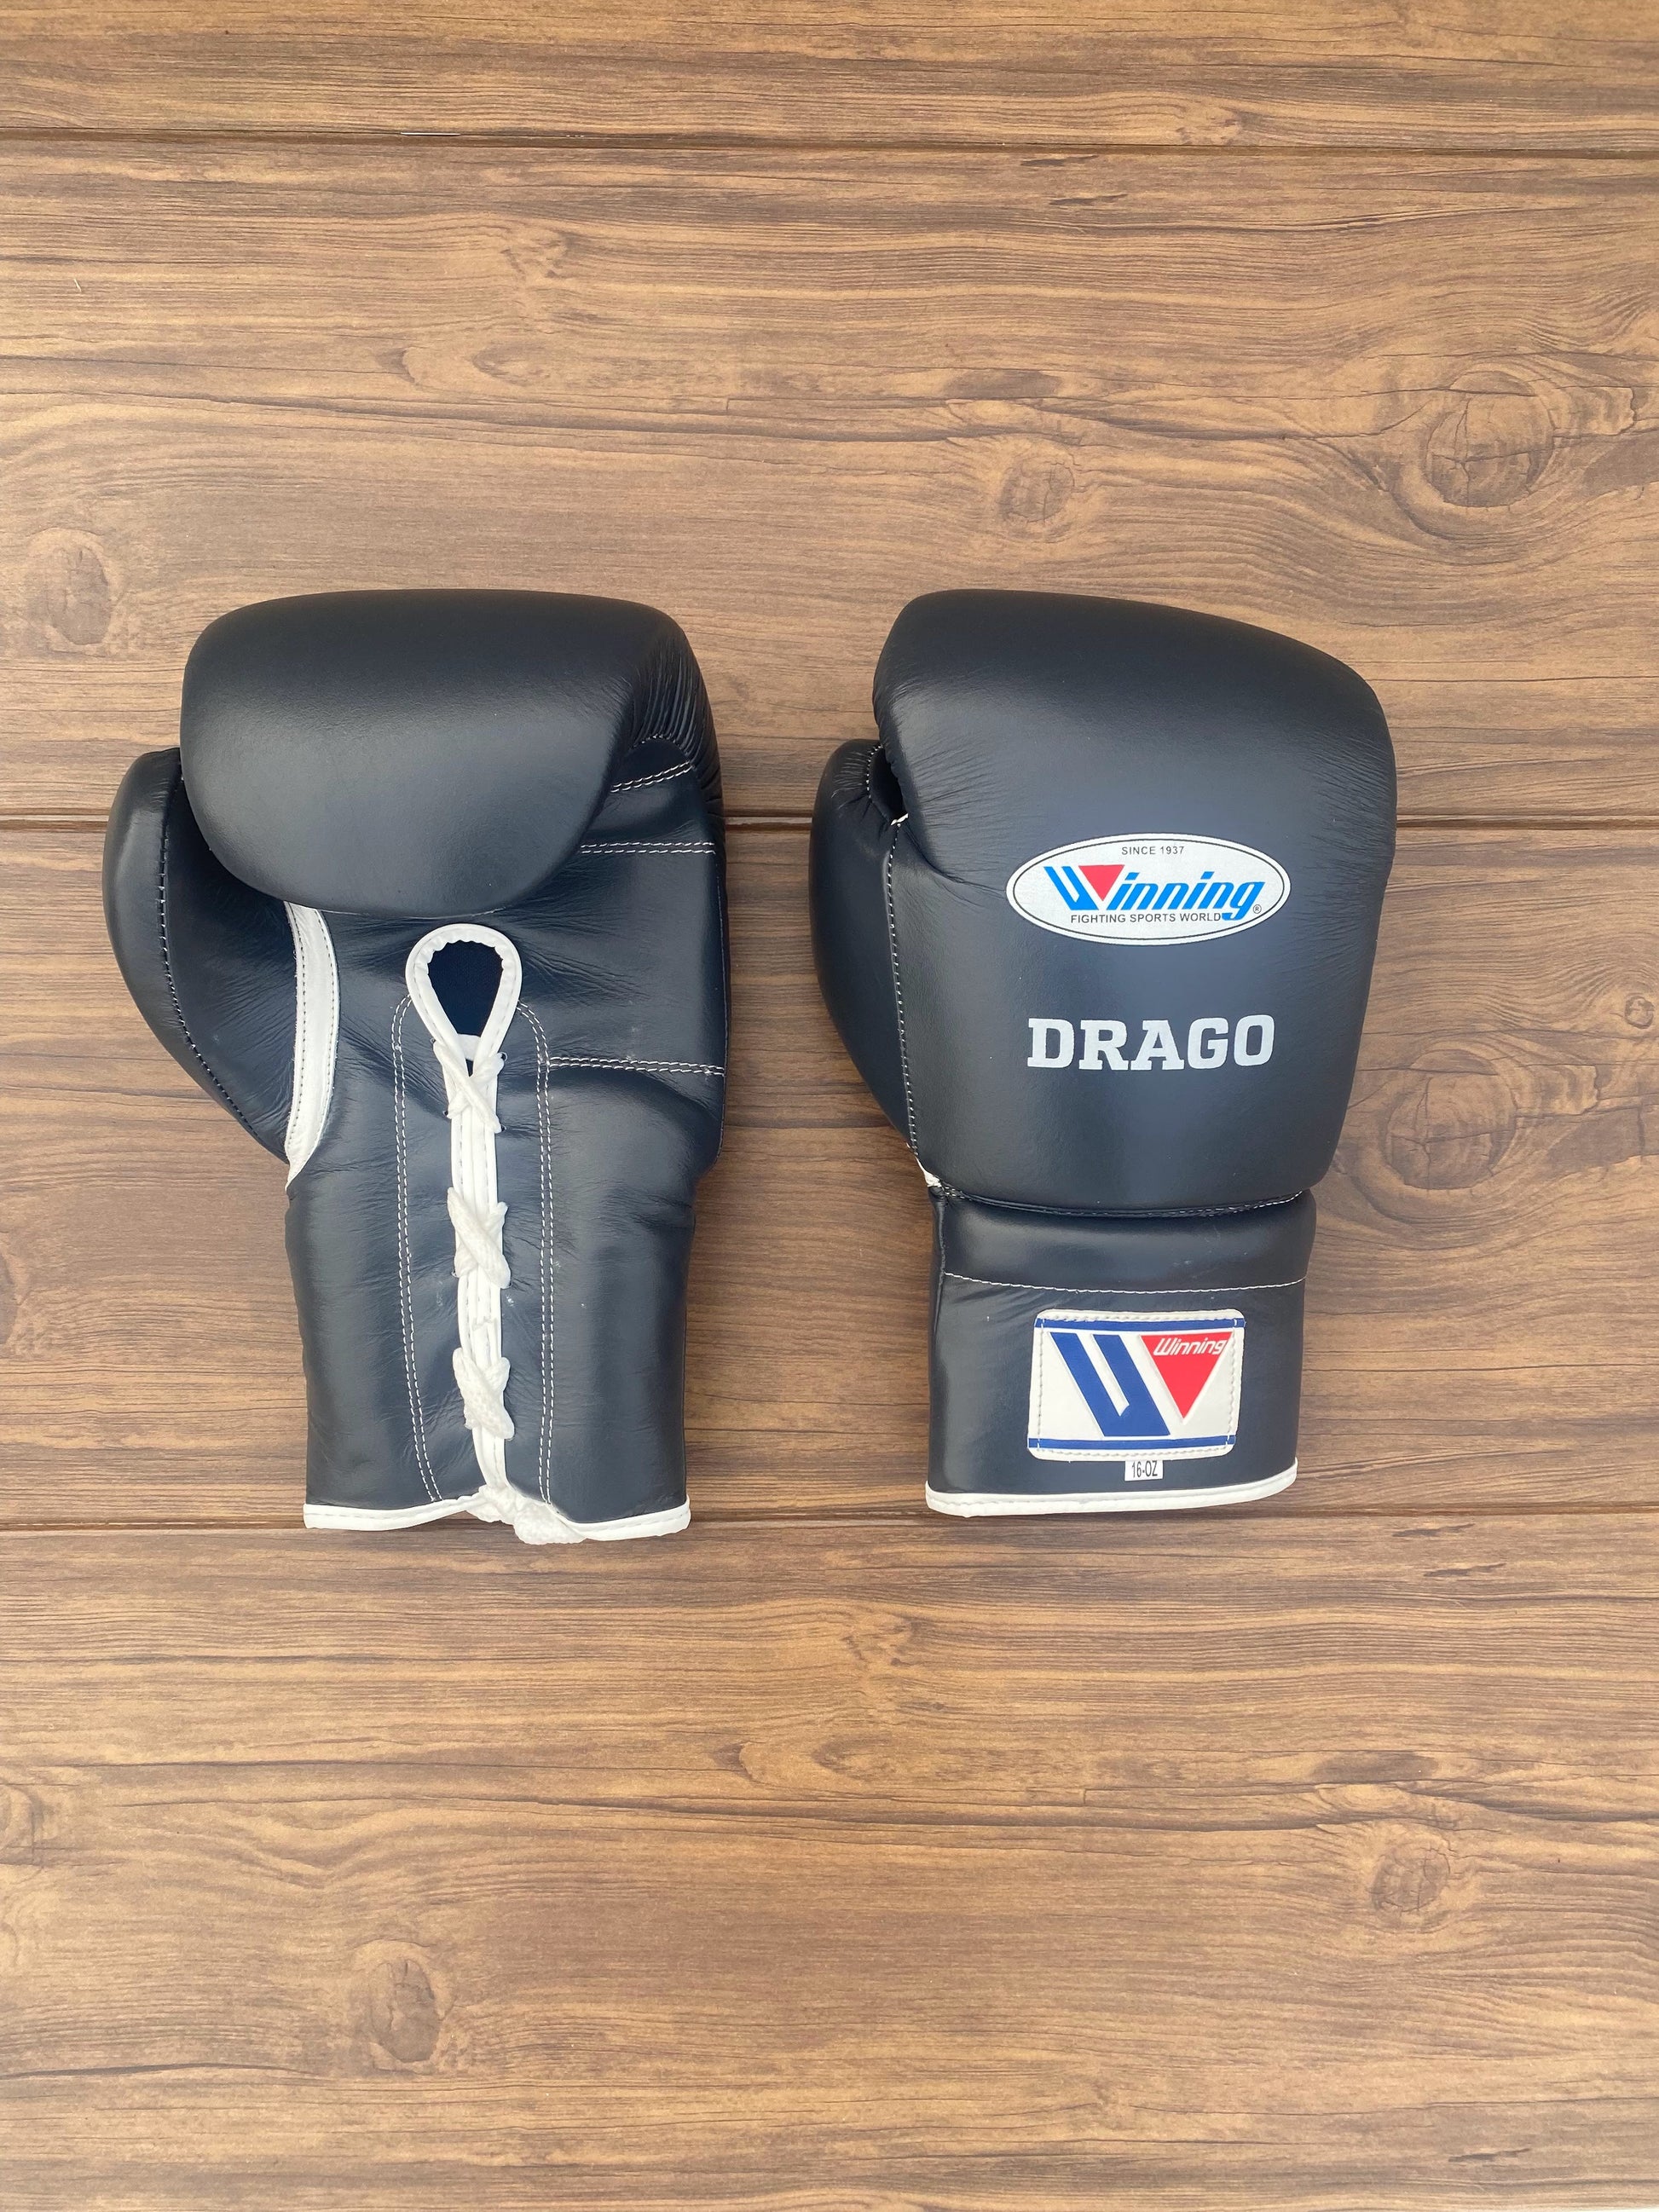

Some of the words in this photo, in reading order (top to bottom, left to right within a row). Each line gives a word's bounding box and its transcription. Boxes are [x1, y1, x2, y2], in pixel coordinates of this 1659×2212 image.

[1121, 846, 1156, 856] SINCE
[1160, 846, 1185, 855] 1937
[1043, 864, 1265, 921] Winning
[1070, 912, 1126, 924] FIGHTING
[1130, 912, 1176, 923] SPORTS
[1179, 911, 1222, 923] WORLD
[1026, 1014, 1275, 1071] DRAGO
[1153, 1337, 1228, 1356] Winning
[1131, 1459, 1159, 1478] 16-OZ
